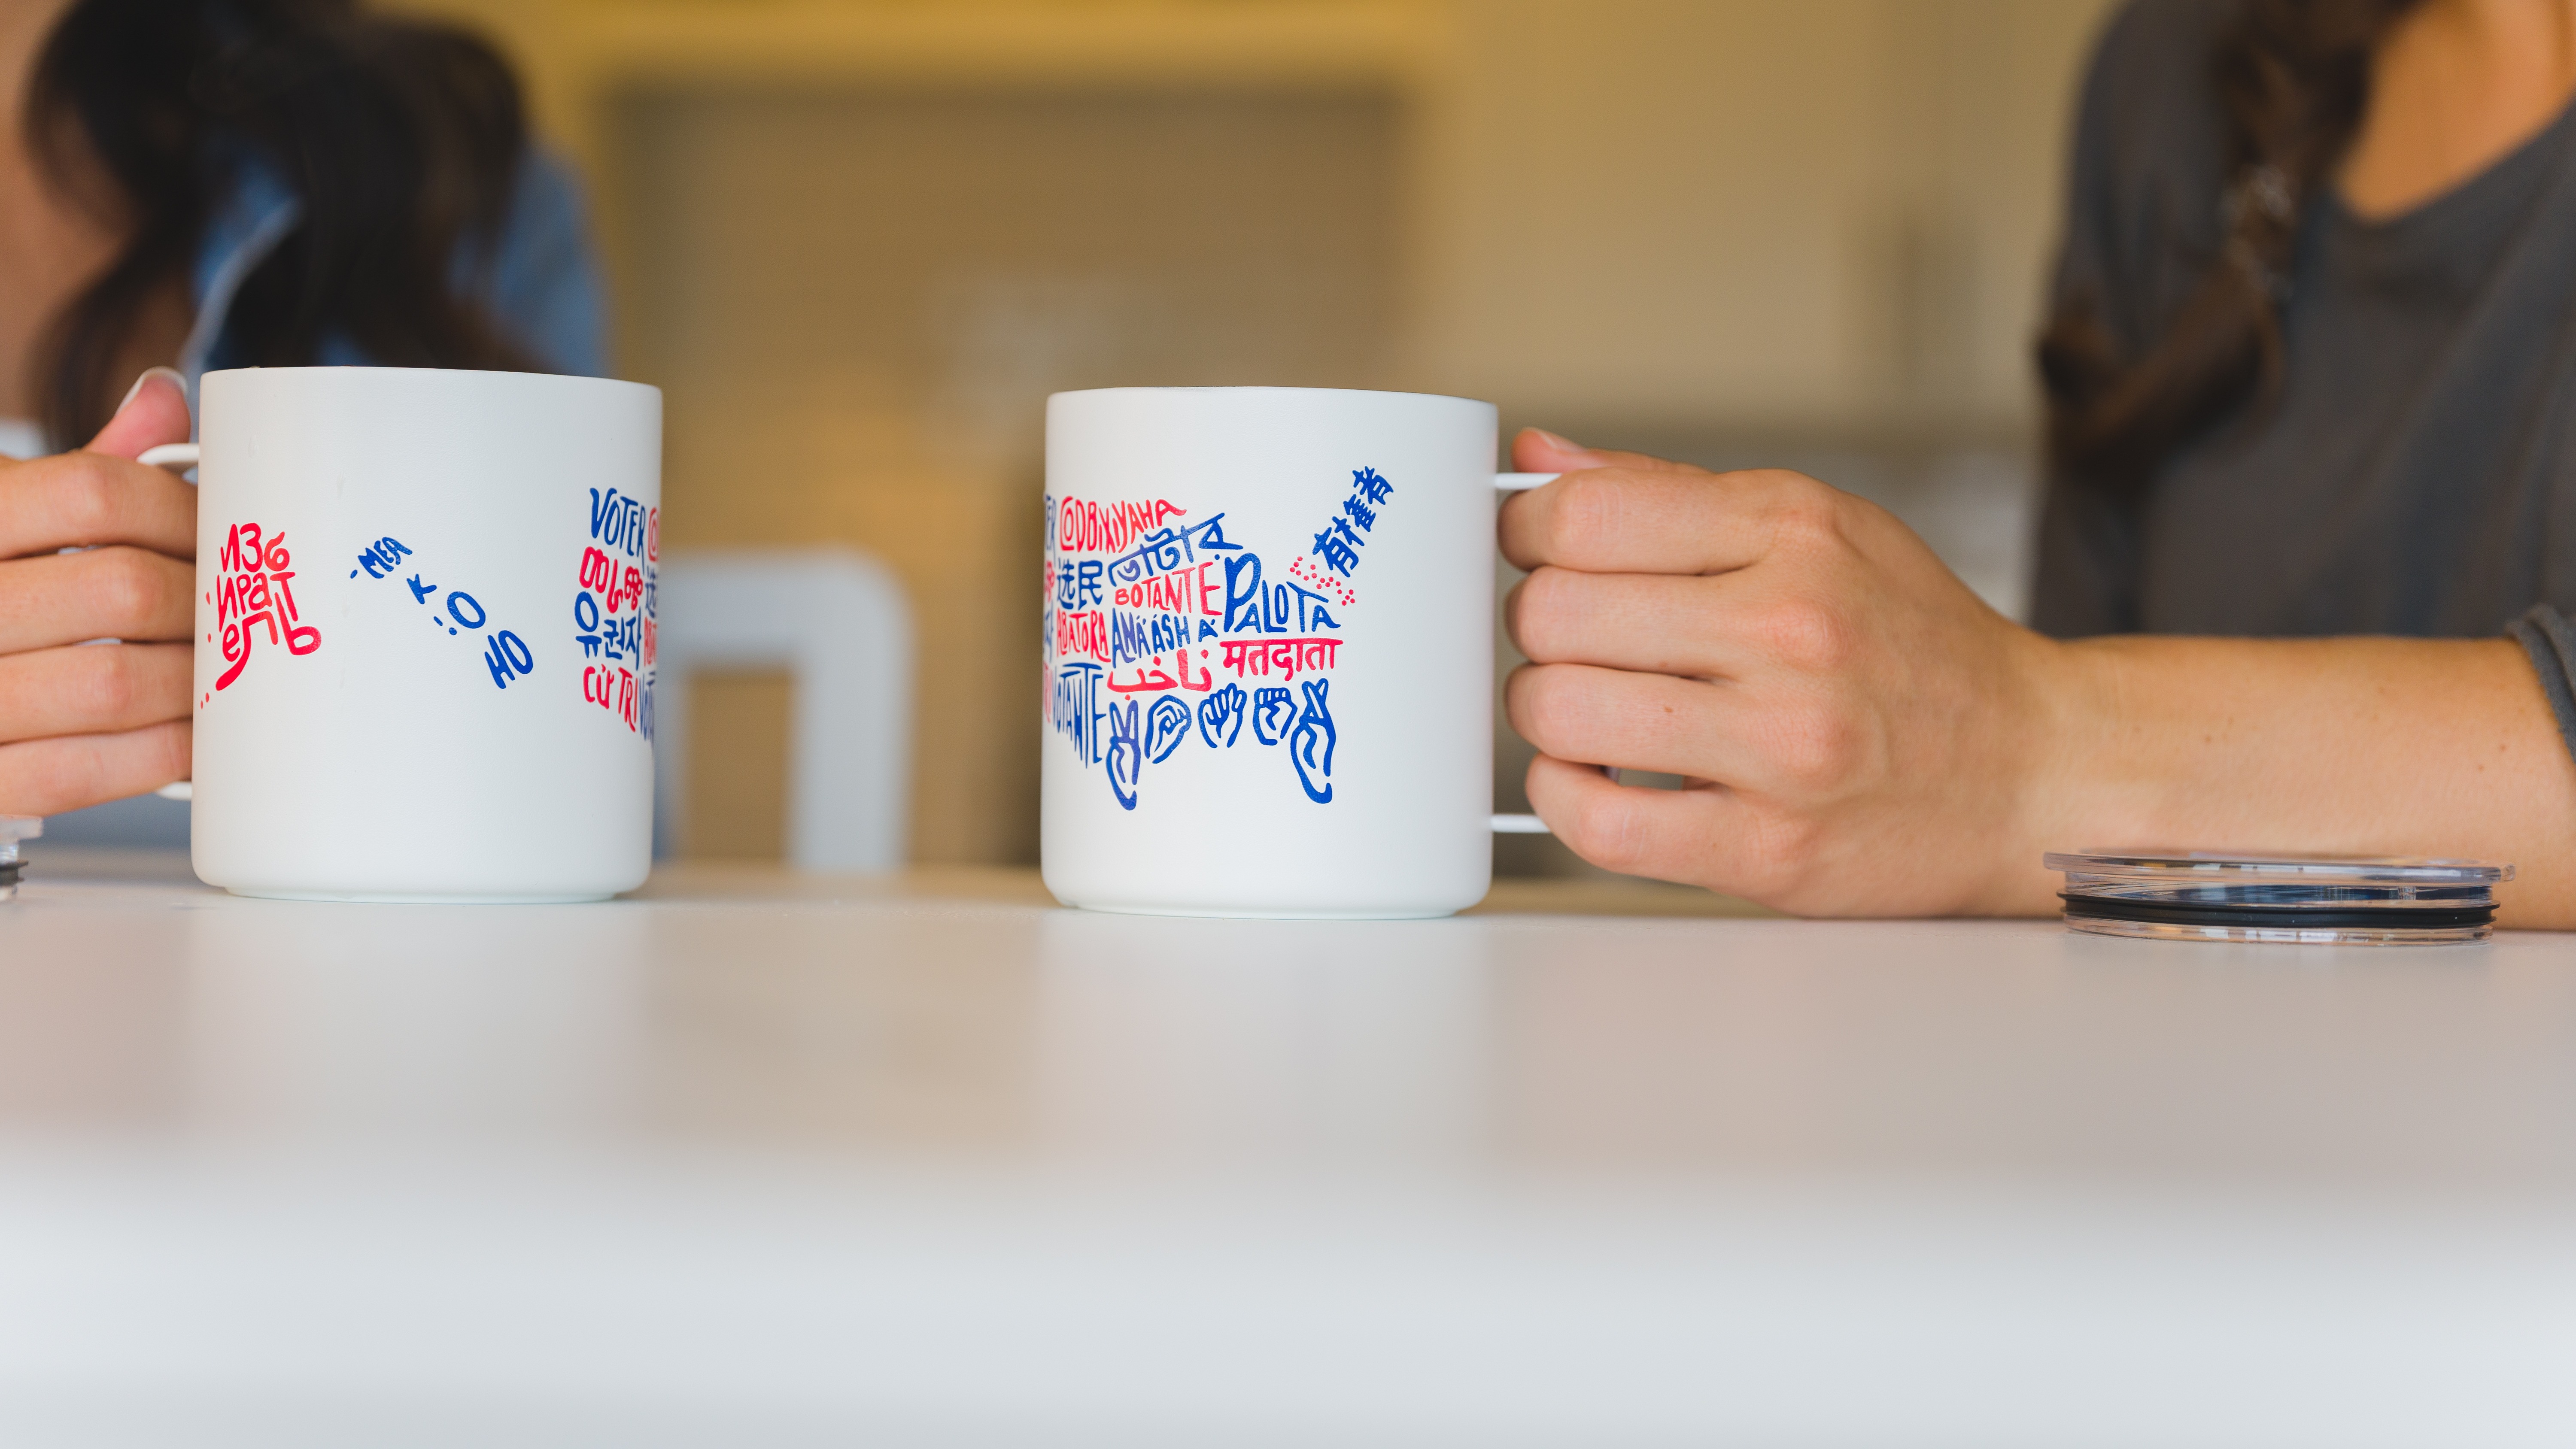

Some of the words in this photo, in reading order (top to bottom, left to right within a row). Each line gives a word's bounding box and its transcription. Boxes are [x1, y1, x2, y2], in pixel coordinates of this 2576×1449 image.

[589, 487, 645, 571] VOTER
[1057, 560, 1103, 610] 选民
[1115, 561, 1223, 615] BOTANTE
[1224, 552, 1341, 634] PALOTA
[574, 591, 642, 671] 유권자
[1056, 607, 1112, 663] ABATORA
[1219, 637, 1344, 681] मतदाता
[618, 667, 638, 733] TRI
[1106, 648, 1212, 701] ناخب
